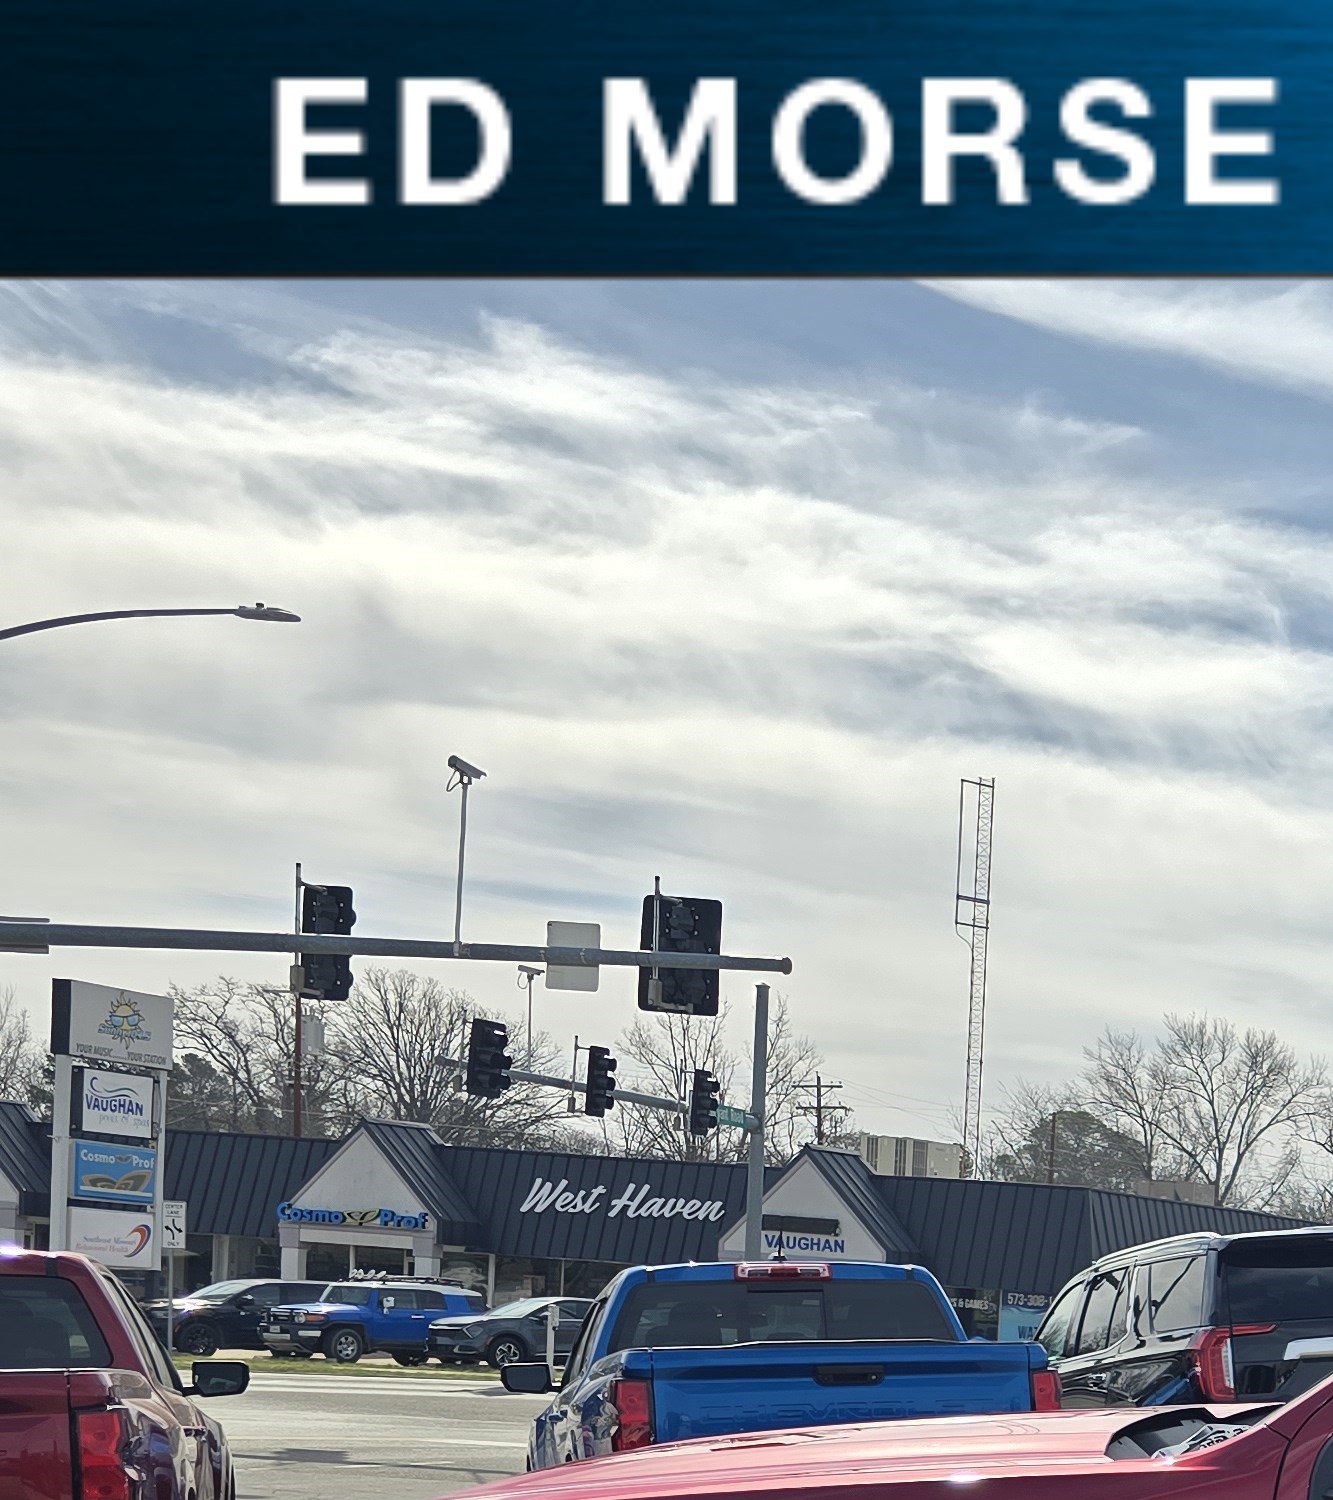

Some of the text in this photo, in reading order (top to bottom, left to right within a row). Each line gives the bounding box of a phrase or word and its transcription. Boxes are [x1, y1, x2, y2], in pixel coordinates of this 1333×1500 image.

[85, 1094, 144, 1116] VAUGHAN
[80, 1149, 155, 1169] Cosmo Prof
[519, 1177, 725, 1222] West Haven
[276, 1201, 429, 1230] Cosmo Prof
[764, 1233, 846, 1254] VAUGHAN
[964, 1298, 989, 1311] GAMES
